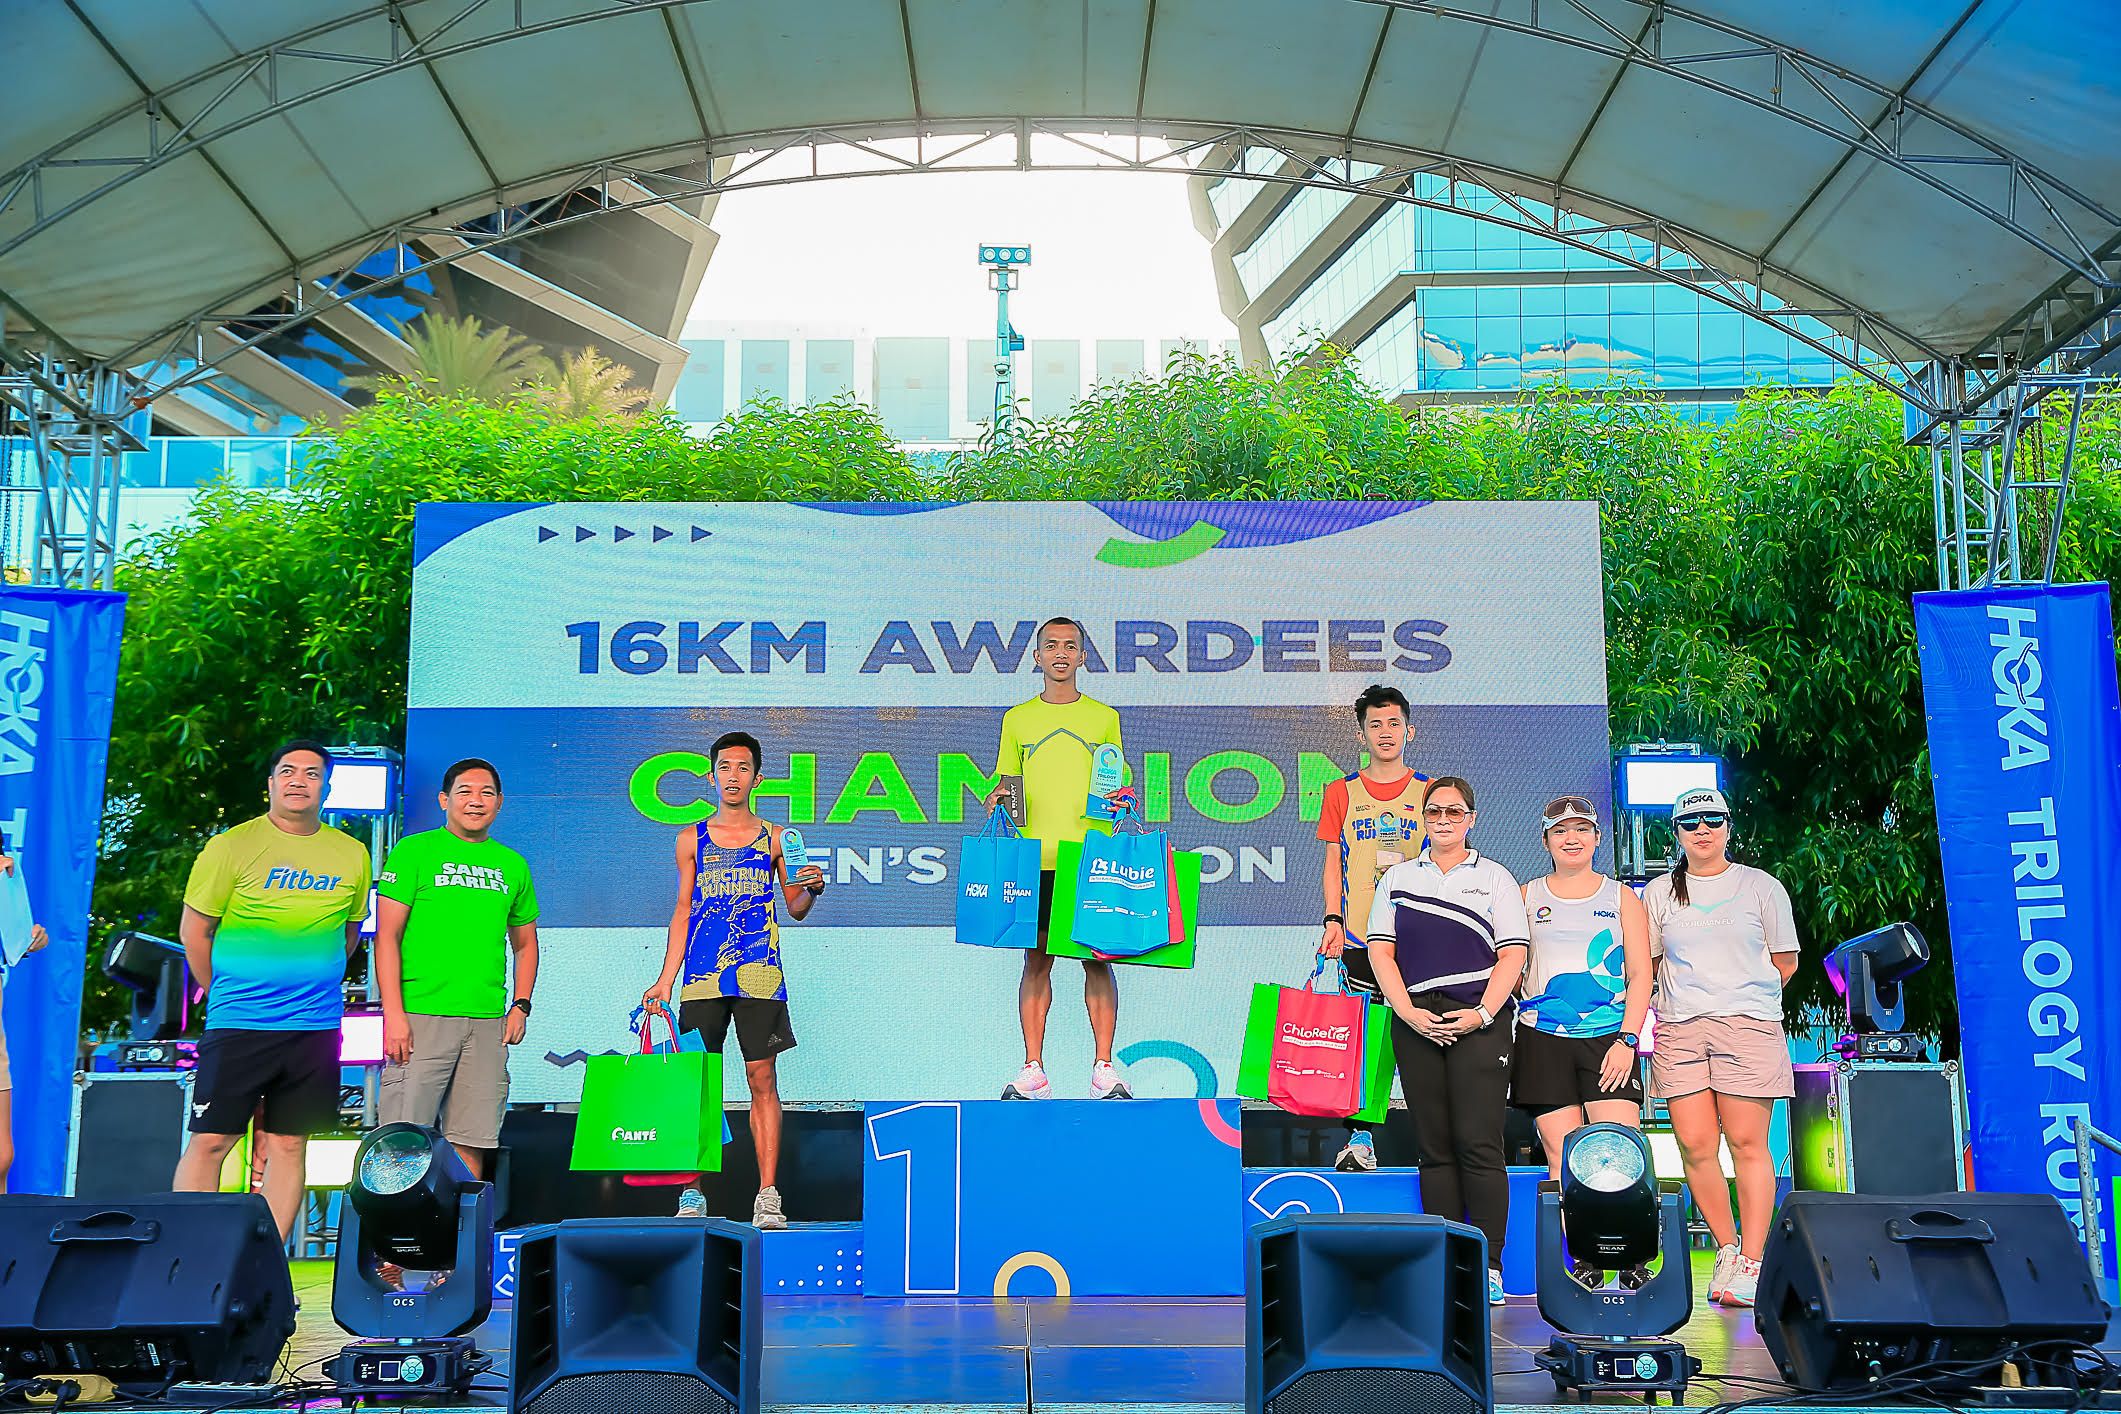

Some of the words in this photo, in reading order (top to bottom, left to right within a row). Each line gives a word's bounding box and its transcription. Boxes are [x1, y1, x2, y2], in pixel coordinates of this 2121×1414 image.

[565, 620, 826, 674] 16KM
[0, 609, 50, 777] HOKA
[1987, 605, 2050, 771] HOKA
[629, 750, 1371, 824] CHAMION
[1682, 794, 1714, 808] HOKA
[1351, 817, 1418, 831] SPEUM
[441, 862, 505, 883] SANTÉ
[773, 846, 947, 884] EN'S
[1110, 860, 1155, 881] Lubie
[263, 867, 342, 891] Fitbar
[434, 874, 509, 895] BARLEY
[696, 866, 770, 887] SPECTRUM
[1003, 881, 1016, 889] FLY
[701, 880, 765, 899] RUNNERS
[965, 883, 989, 897] HOKA
[1003, 889, 1032, 897] HUMAN
[1593, 910, 1617, 920] HOKA
[1691, 919, 1721, 928] HUMAN
[1722, 918, 1736, 926] FLY
[2007, 796, 2086, 1082] TRILOGY
[1282, 1022, 1351, 1042] ChloRelief
[611, 1126, 657, 1141] SANTÉ
[866, 1101, 961, 1294] 1
[392, 1297, 415, 1307] OCS
[1603, 1296, 1625, 1305] OCS
